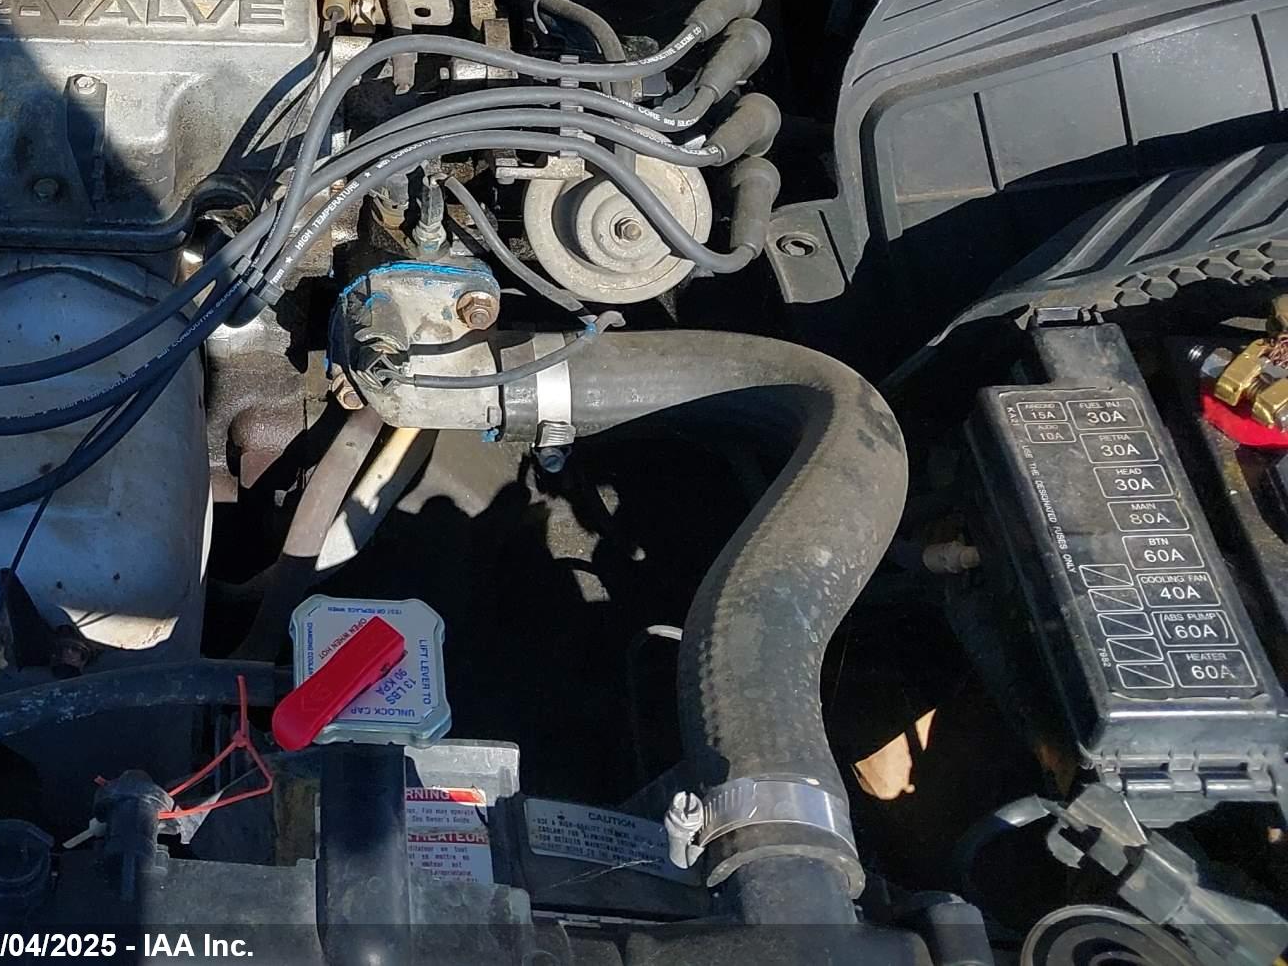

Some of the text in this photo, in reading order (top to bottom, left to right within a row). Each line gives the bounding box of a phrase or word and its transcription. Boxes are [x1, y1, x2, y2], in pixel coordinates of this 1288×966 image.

[295, 229, 313, 250] HIGH
[313, 181, 360, 229] TEMPERATURE
[1031, 411, 1056, 420] 15A
[1087, 410, 1126, 423] 30A
[1040, 432, 1064, 441] 10A
[1100, 444, 1141, 457] 30A
[1115, 477, 1155, 491] 30A
[1022, 445, 1077, 574] USE THE DESIGNATED FUSES ONLY
[1130, 513, 1171, 525] 80A
[1149, 537, 1169, 546] BTN
[1144, 548, 1185, 563] 60A
[1140, 575, 1184, 583] COOLING
[1160, 585, 1201, 600] 40A
[1175, 624, 1218, 638] 60A
[318, 617, 368, 660] OPEN WHEN HOT
[395, 668, 408, 681] 90
[418, 639, 431, 705] LIFT LEVER TO
[1191, 665, 1236, 680] 60A
[376, 678, 397, 696] KPA
[385, 678, 416, 705] 13 LBS
[350, 707, 415, 718] UNLOCK CAP
[405, 789, 450, 800] RNING
[588, 812, 636, 828] CAUTION
